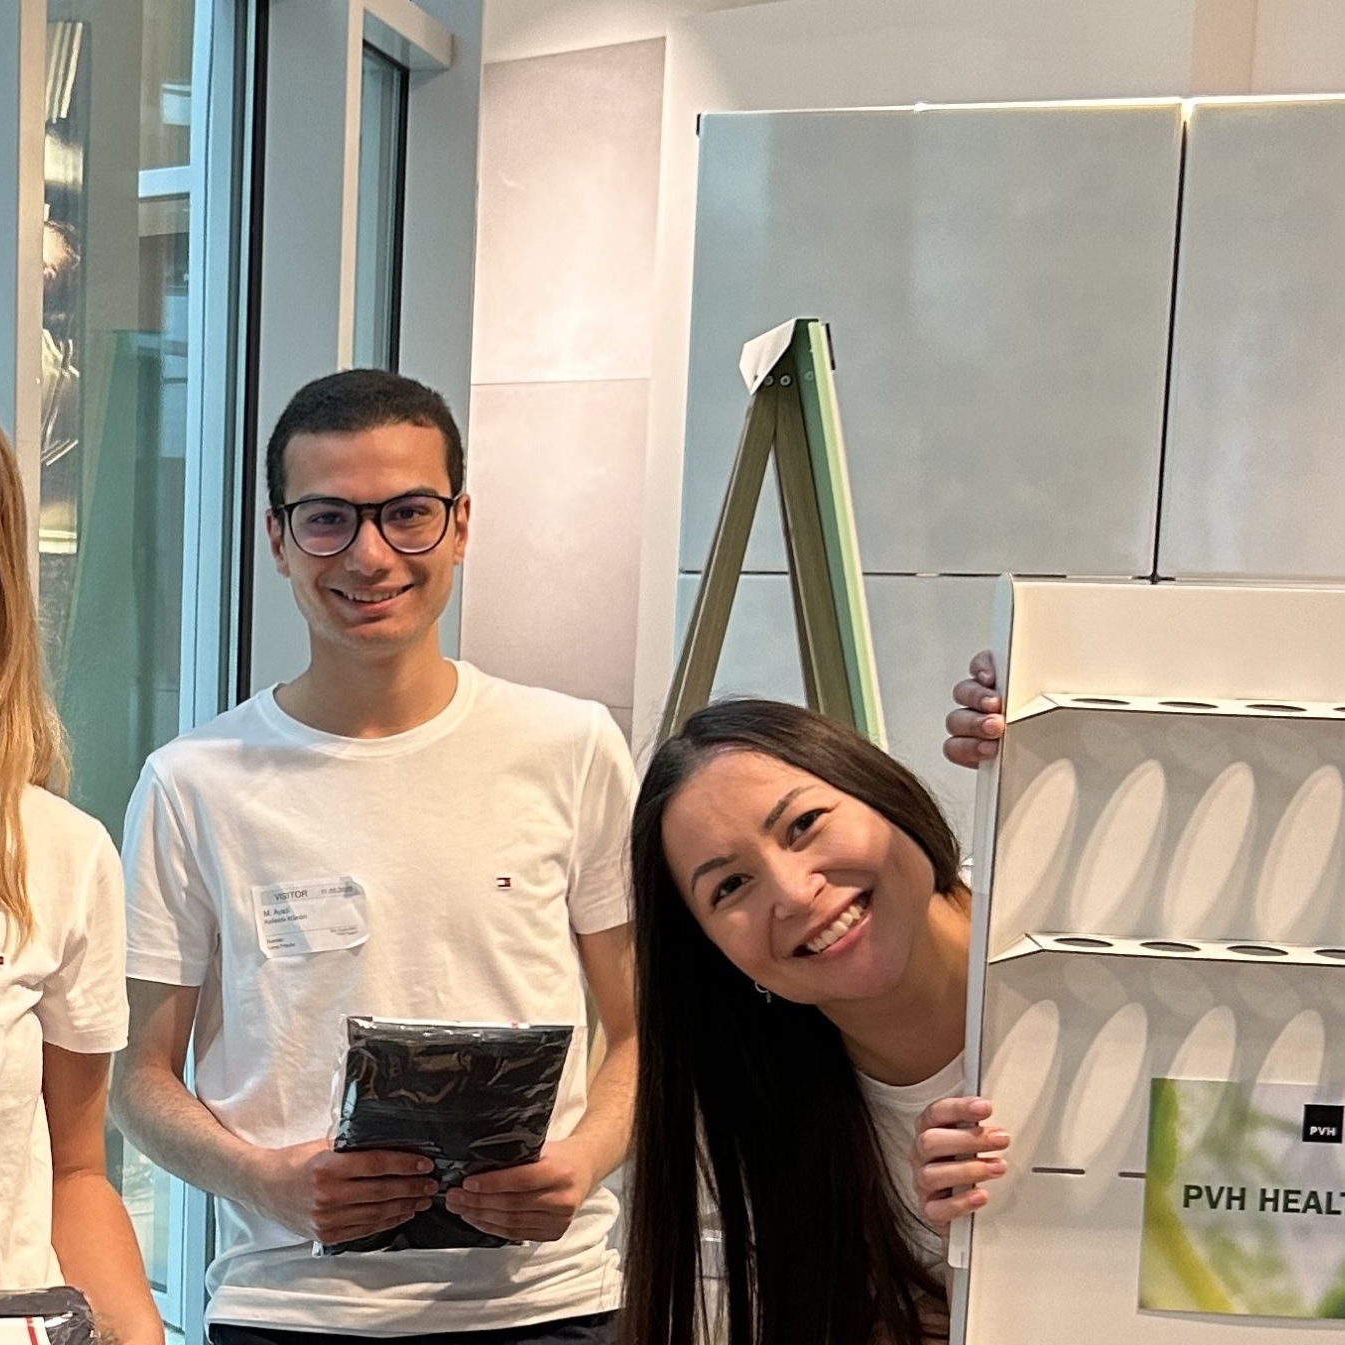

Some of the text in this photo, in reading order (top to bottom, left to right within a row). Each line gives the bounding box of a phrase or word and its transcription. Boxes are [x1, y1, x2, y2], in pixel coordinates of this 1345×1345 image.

[274, 889, 308, 901] VISITOR
[1310, 1126, 1336, 1137] PVH
[1183, 1184, 1247, 1211] PVH
